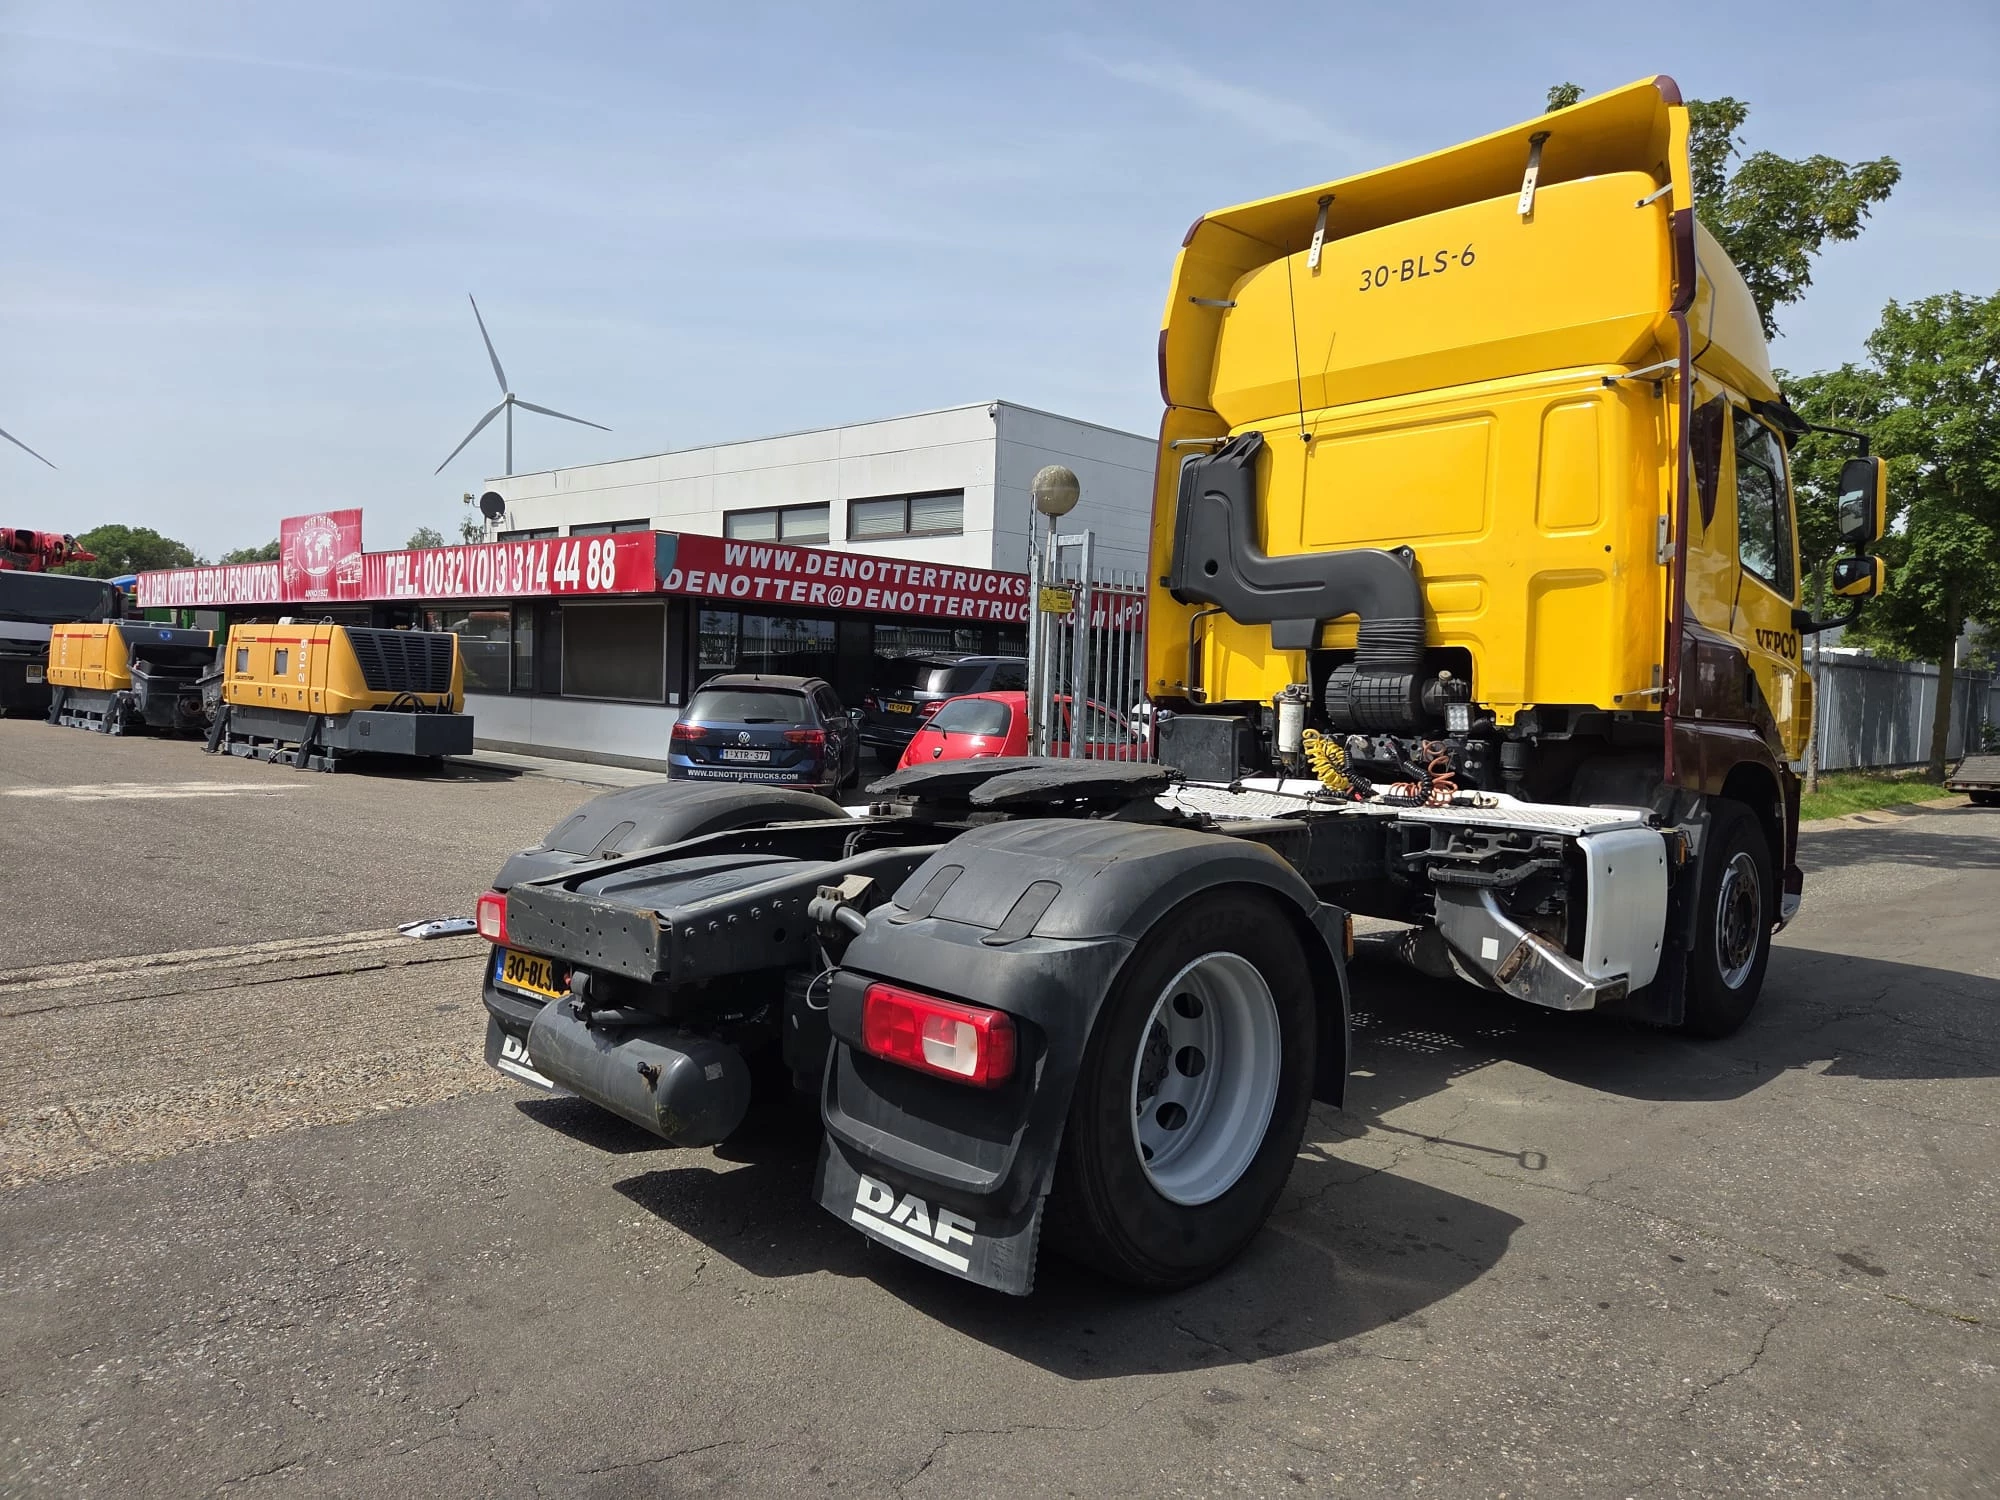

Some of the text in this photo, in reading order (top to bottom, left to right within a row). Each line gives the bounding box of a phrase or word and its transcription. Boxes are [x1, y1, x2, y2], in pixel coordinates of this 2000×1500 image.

[1359, 243, 1476, 292] 30-BLS-6
[168, 571, 196, 603] OTTER
[197, 564, 279, 603] BEDRIJFSAUTO'S
[385, 555, 420, 596] TEL:
[423, 550, 465, 595] 0032
[512, 543, 549, 592] 314
[553, 540, 581, 591] 44
[586, 538, 616, 590] 88
[724, 543, 1080, 604] WWW.DENOTTERTRUCKS.
[687, 769, 799, 780] WWW.DENOTTERTRUCKS.COM
[506, 955, 552, 992] 30-BLS
[855, 1173, 977, 1247] DAF
